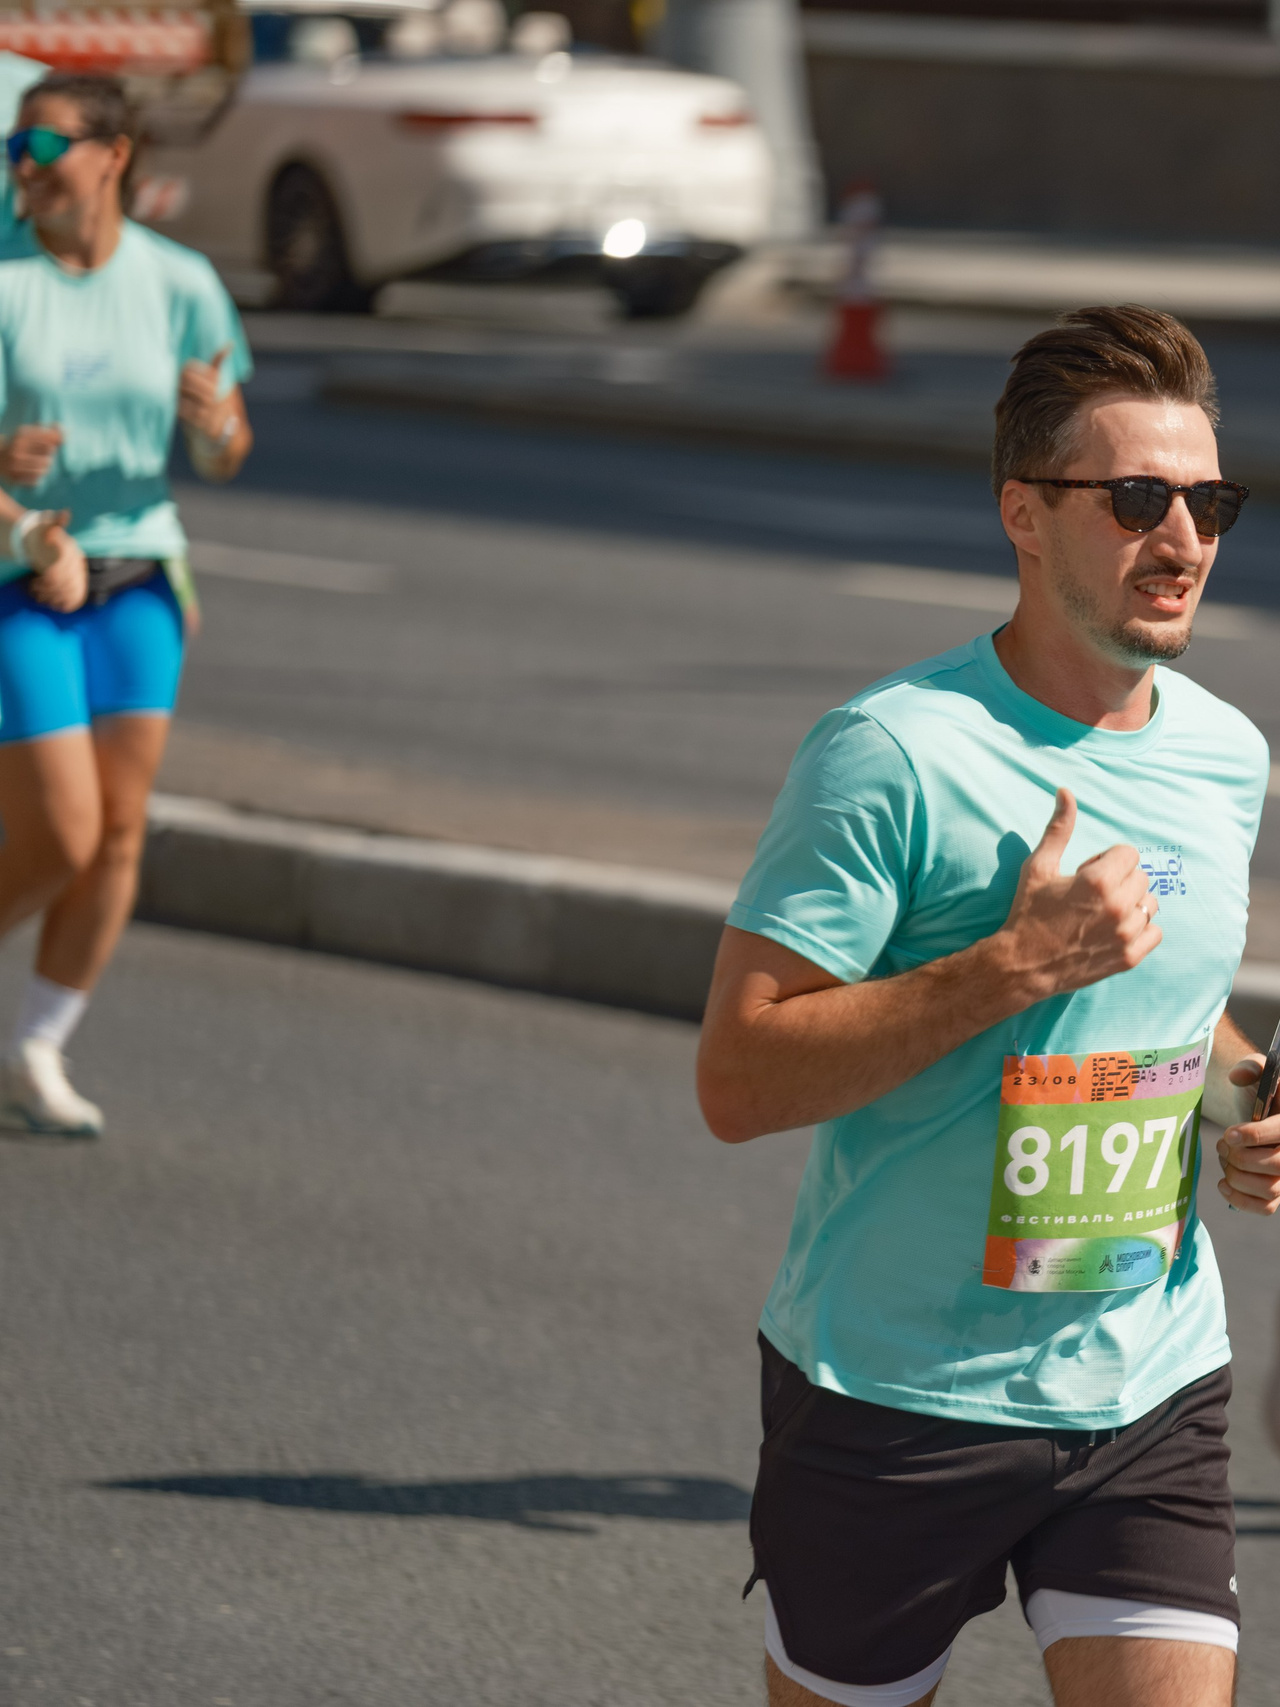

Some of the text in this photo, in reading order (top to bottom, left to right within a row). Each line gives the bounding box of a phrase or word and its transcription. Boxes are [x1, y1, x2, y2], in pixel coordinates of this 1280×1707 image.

[1157, 845, 1182, 853] FEST
[1169, 1062, 1179, 1075] 5
[1012, 1075, 1077, 1086] 23/08
[1003, 1110, 1195, 1196] 81971
[1001, 1196, 1189, 1225] ФЕСТИВАЛЬ ДВИЖЕНИЯ
[1116, 1262, 1135, 1273] СПОРТ
